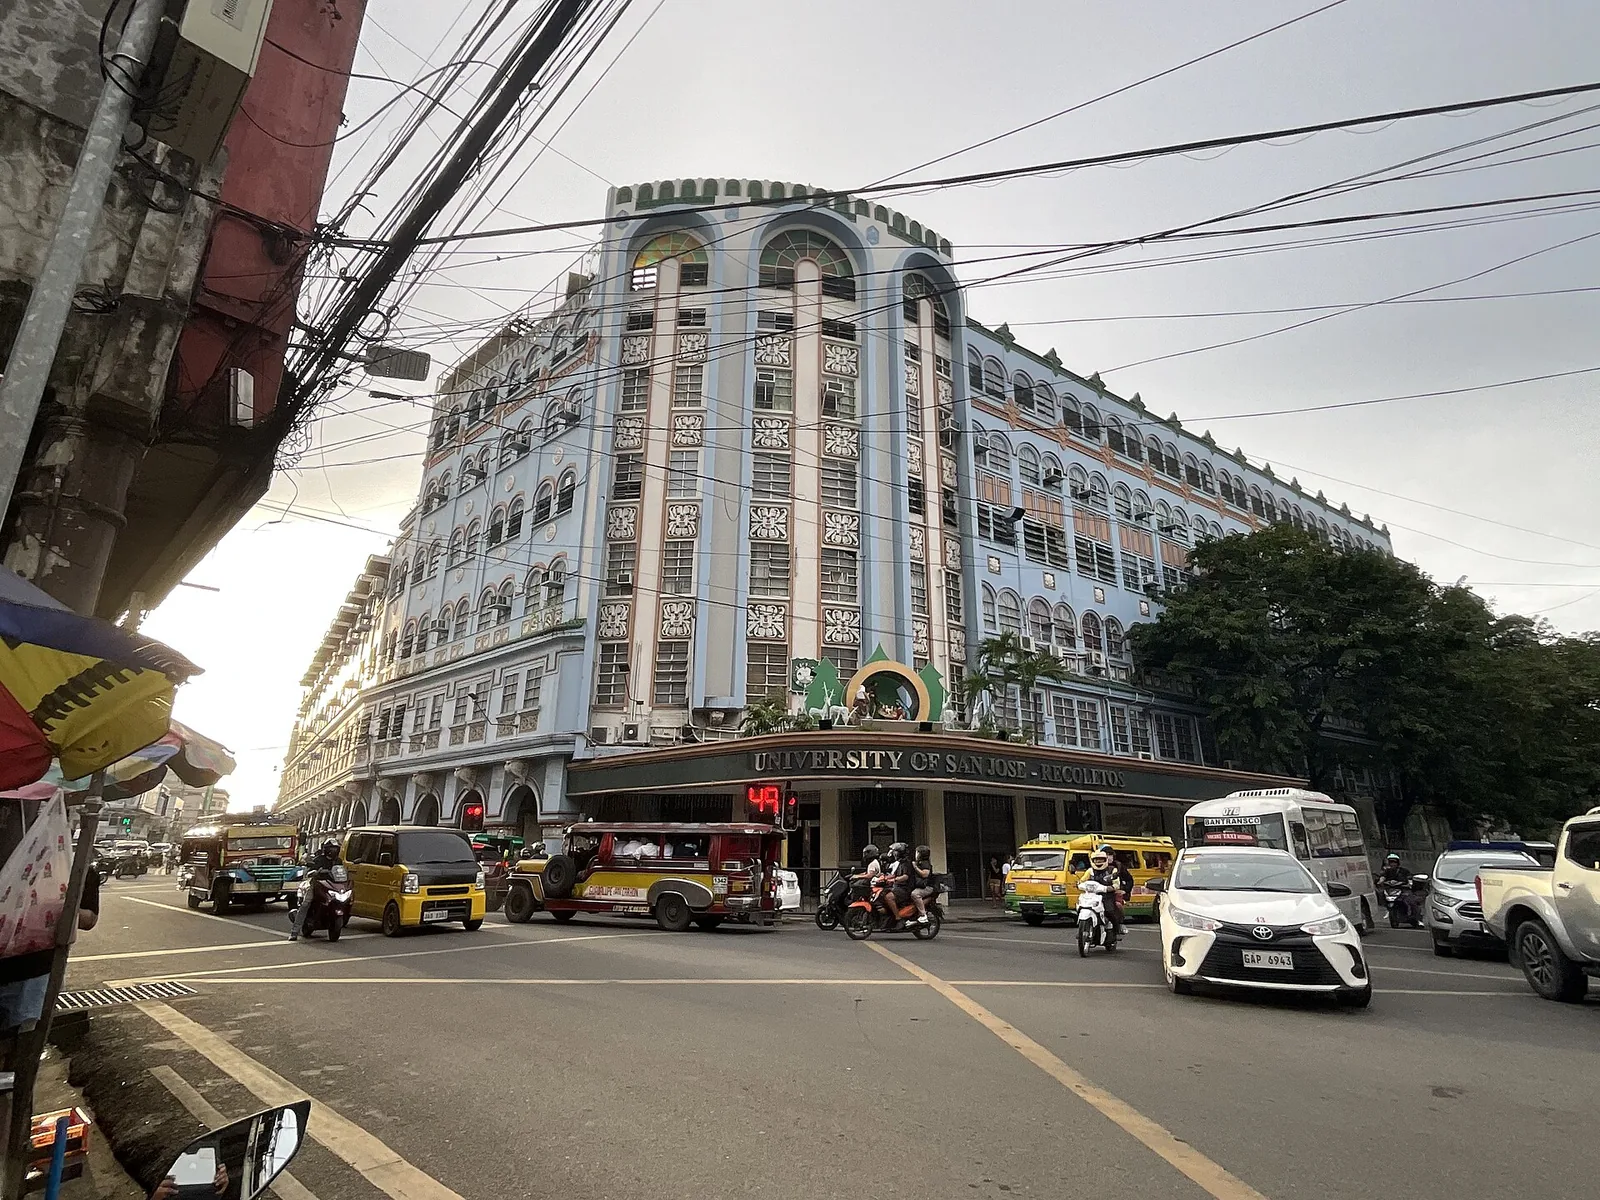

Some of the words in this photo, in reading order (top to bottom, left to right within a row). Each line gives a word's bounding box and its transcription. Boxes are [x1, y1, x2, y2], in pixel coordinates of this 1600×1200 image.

[754, 750, 903, 771] UNIVERSITY
[910, 751, 940, 771] OF
[946, 754, 983, 775] SAN
[987, 757, 1027, 778] JOSE
[1040, 762, 1126, 788] RECOLETOS
[748, 786, 779, 813] 49
[1204, 817, 1260, 826] BANTRANSCO
[1244, 954, 1262, 964] GAP
[1268, 955, 1291, 966] 6943
